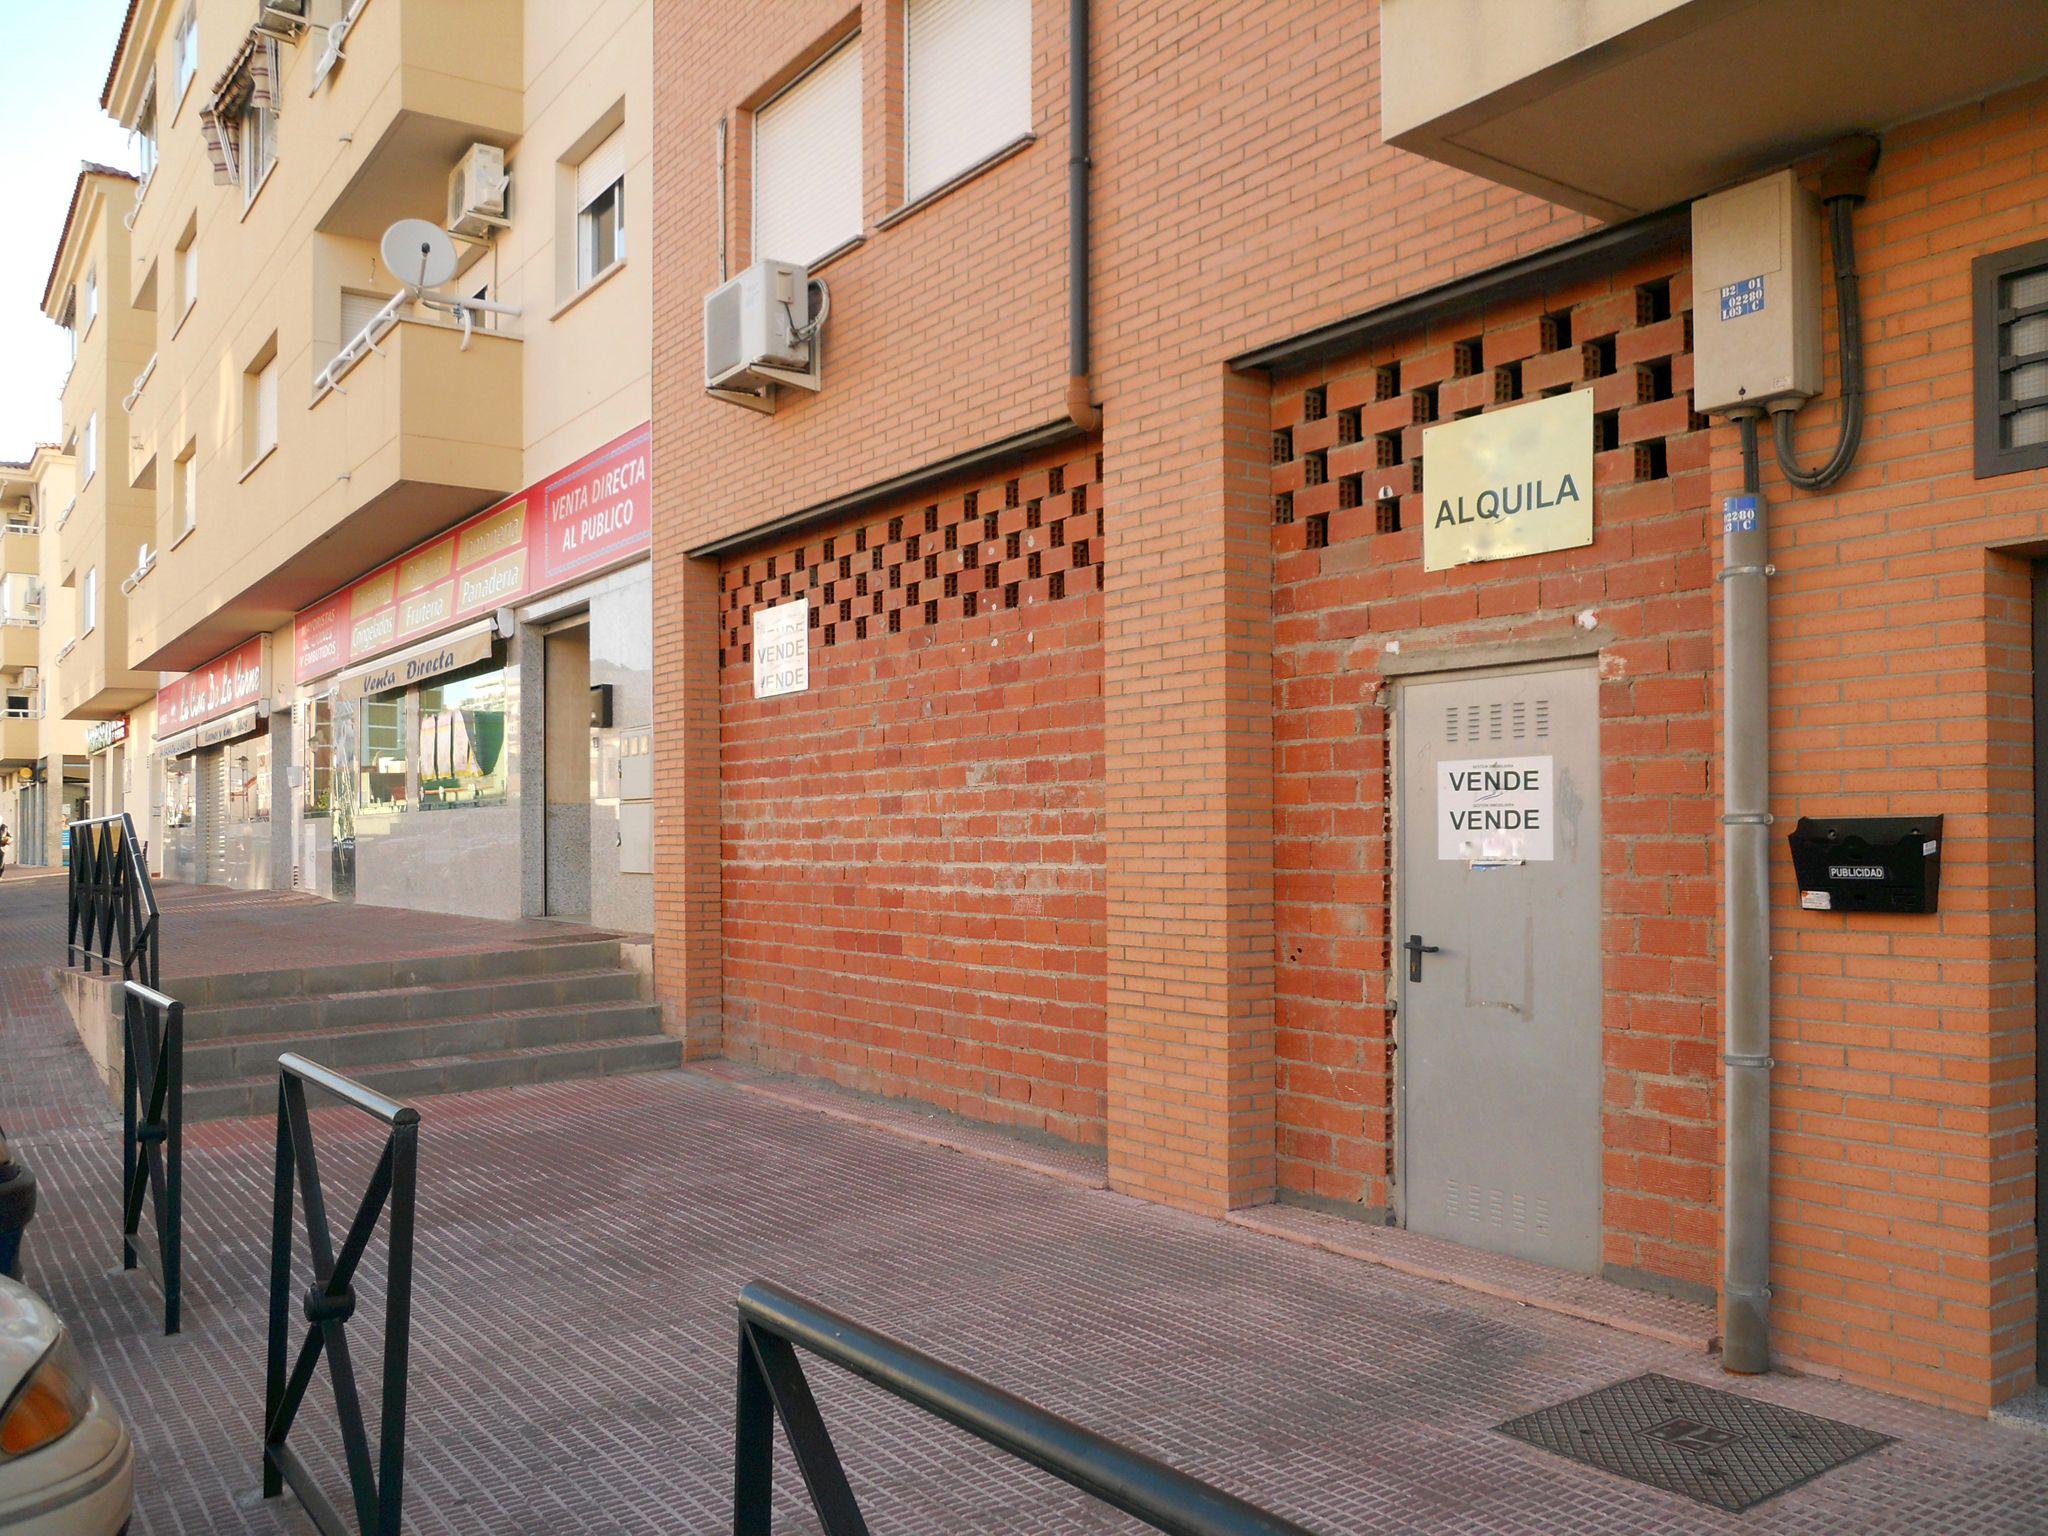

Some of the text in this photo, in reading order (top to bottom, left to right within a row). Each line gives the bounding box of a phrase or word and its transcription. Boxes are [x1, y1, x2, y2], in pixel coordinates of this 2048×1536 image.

[1722, 277, 1761, 298] B2 01
[1728, 289, 1763, 307] 02280
[1722, 300, 1760, 320] L03 C
[552, 455, 645, 523] VENTA DIRECTA
[1434, 473, 1580, 529] ALQUILA
[562, 499, 634, 552] AL PUBLICO
[1742, 520, 1752, 530] C
[758, 639, 805, 664] VENDE
[363, 650, 454, 692] Venta Directa
[1449, 770, 1540, 792] VENDE
[1449, 809, 1540, 831] VENDE
[1830, 867, 1883, 878] PUBLICIDAD
